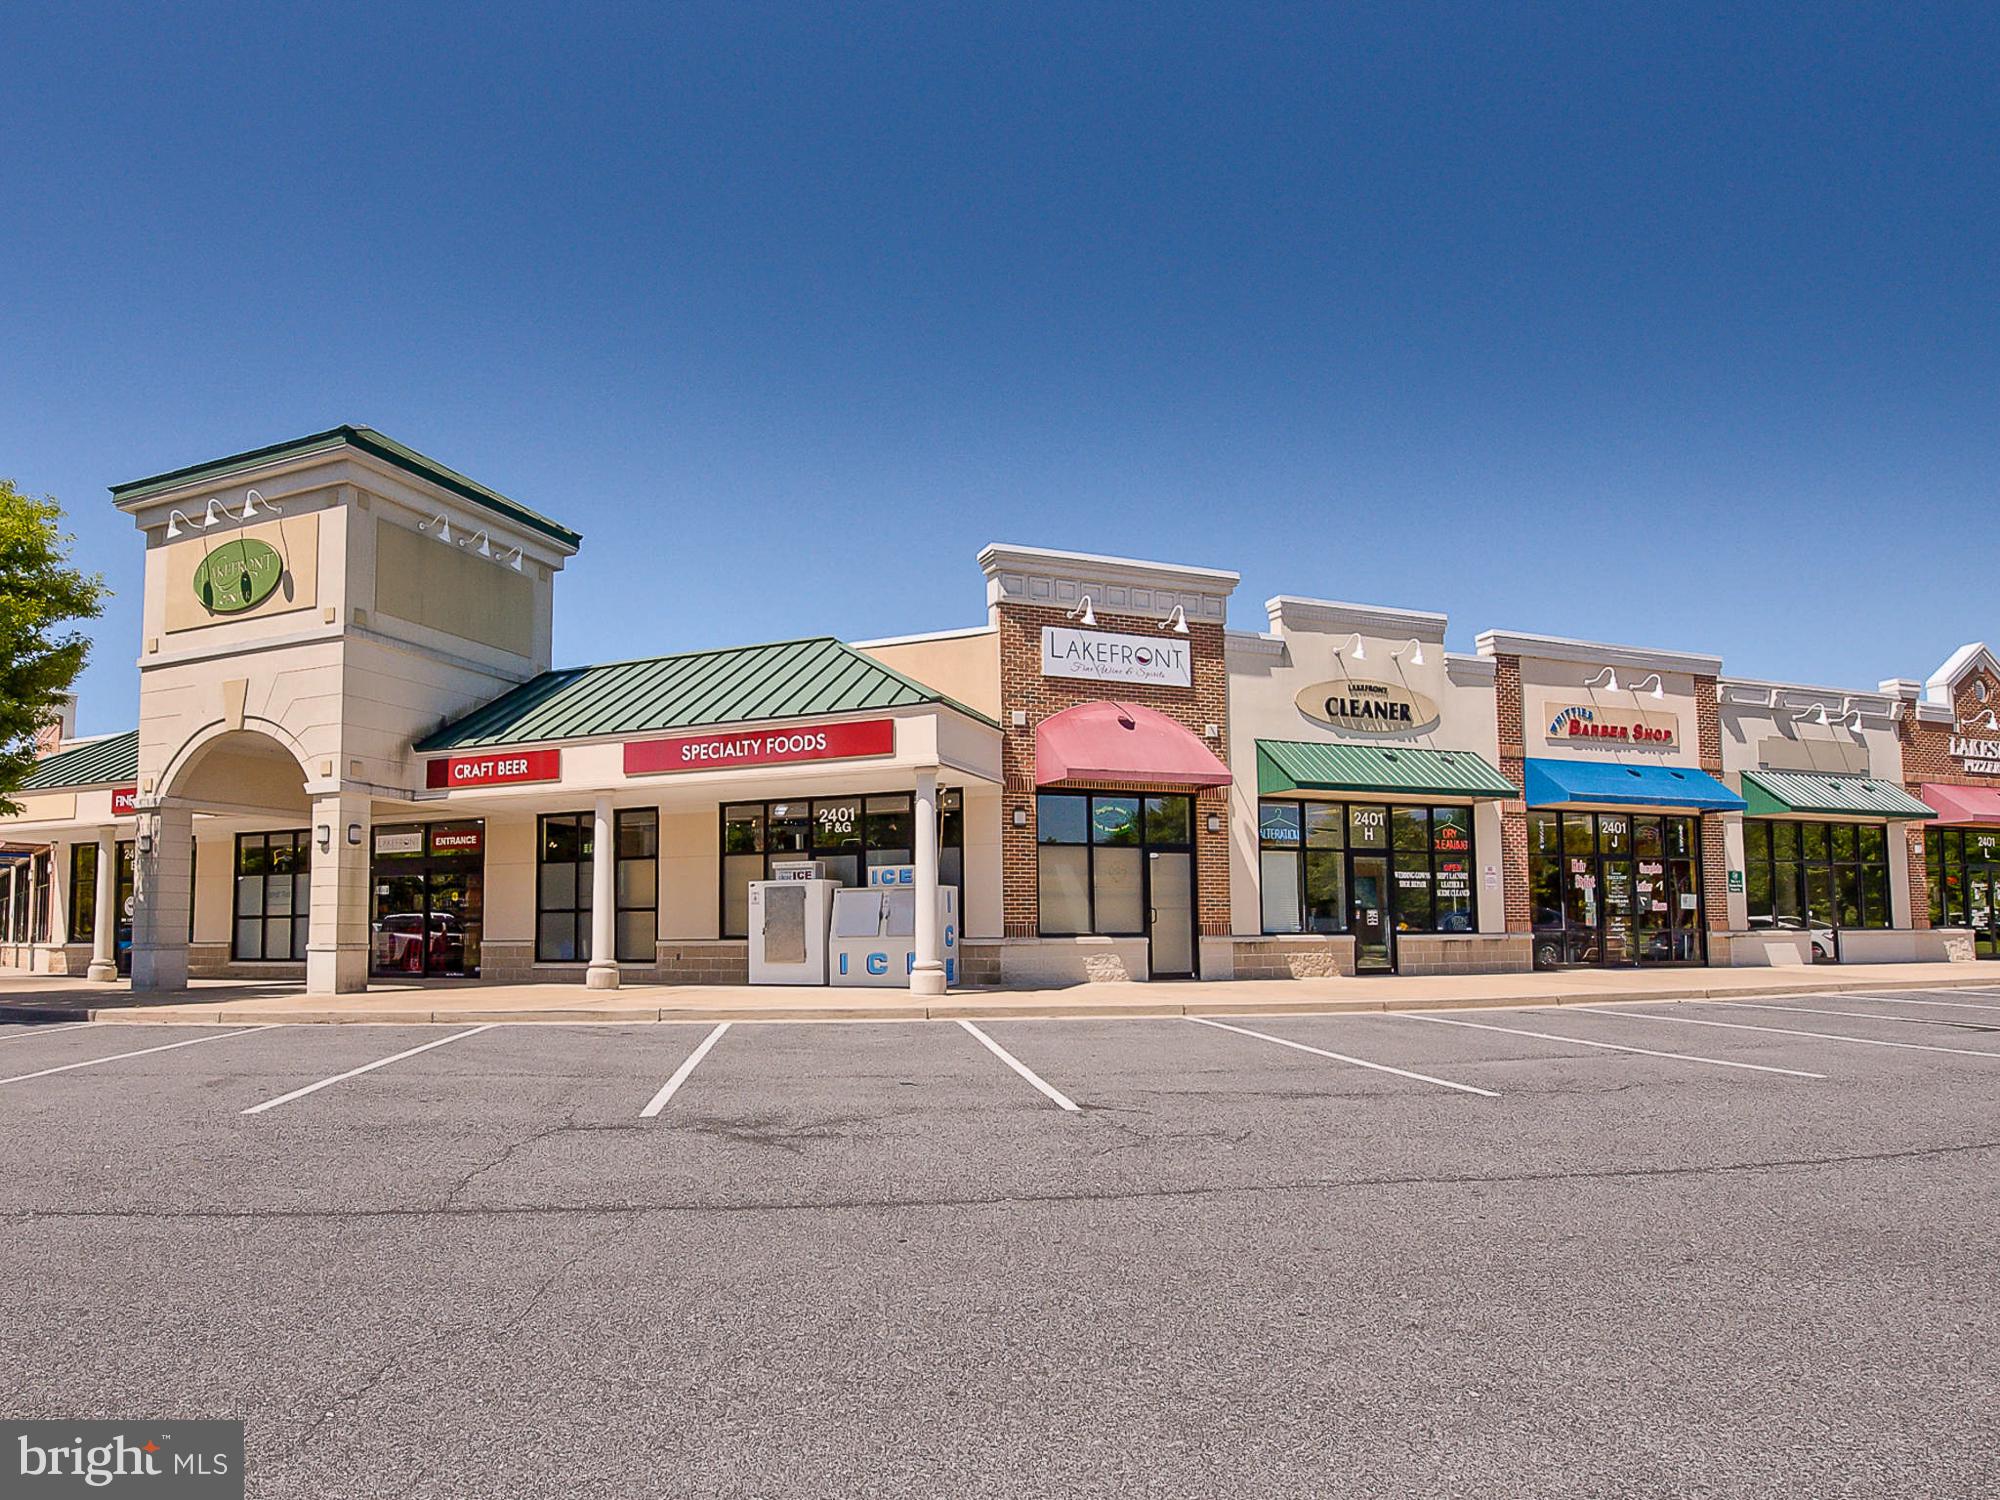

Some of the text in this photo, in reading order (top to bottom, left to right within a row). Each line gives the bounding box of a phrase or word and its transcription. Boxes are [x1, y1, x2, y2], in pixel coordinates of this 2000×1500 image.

[1051, 631, 1183, 669] LAKEFRONT
[1070, 661, 1094, 672] Fine
[1135, 668, 1165, 680] Spirits
[1348, 684, 1388, 695] LAKEFRONT
[1324, 697, 1412, 722] CLEANER
[1568, 718, 1673, 742] BARBER SHOP
[681, 733, 827, 761] SPECIALTY FOODS
[454, 759, 528, 779] CRAFT BEER
[819, 798, 855, 823] 2401
[1353, 811, 1384, 827] 2401
[1364, 828, 1374, 841] H
[1442, 828, 1457, 839] DRY
[1601, 821, 1627, 834] 2401
[435, 835, 477, 846] ENTRANCE
[1611, 835, 1618, 848] J
[1978, 836, 1996, 848] 2401
[792, 870, 812, 881] ICE
[871, 868, 913, 885] ICE
